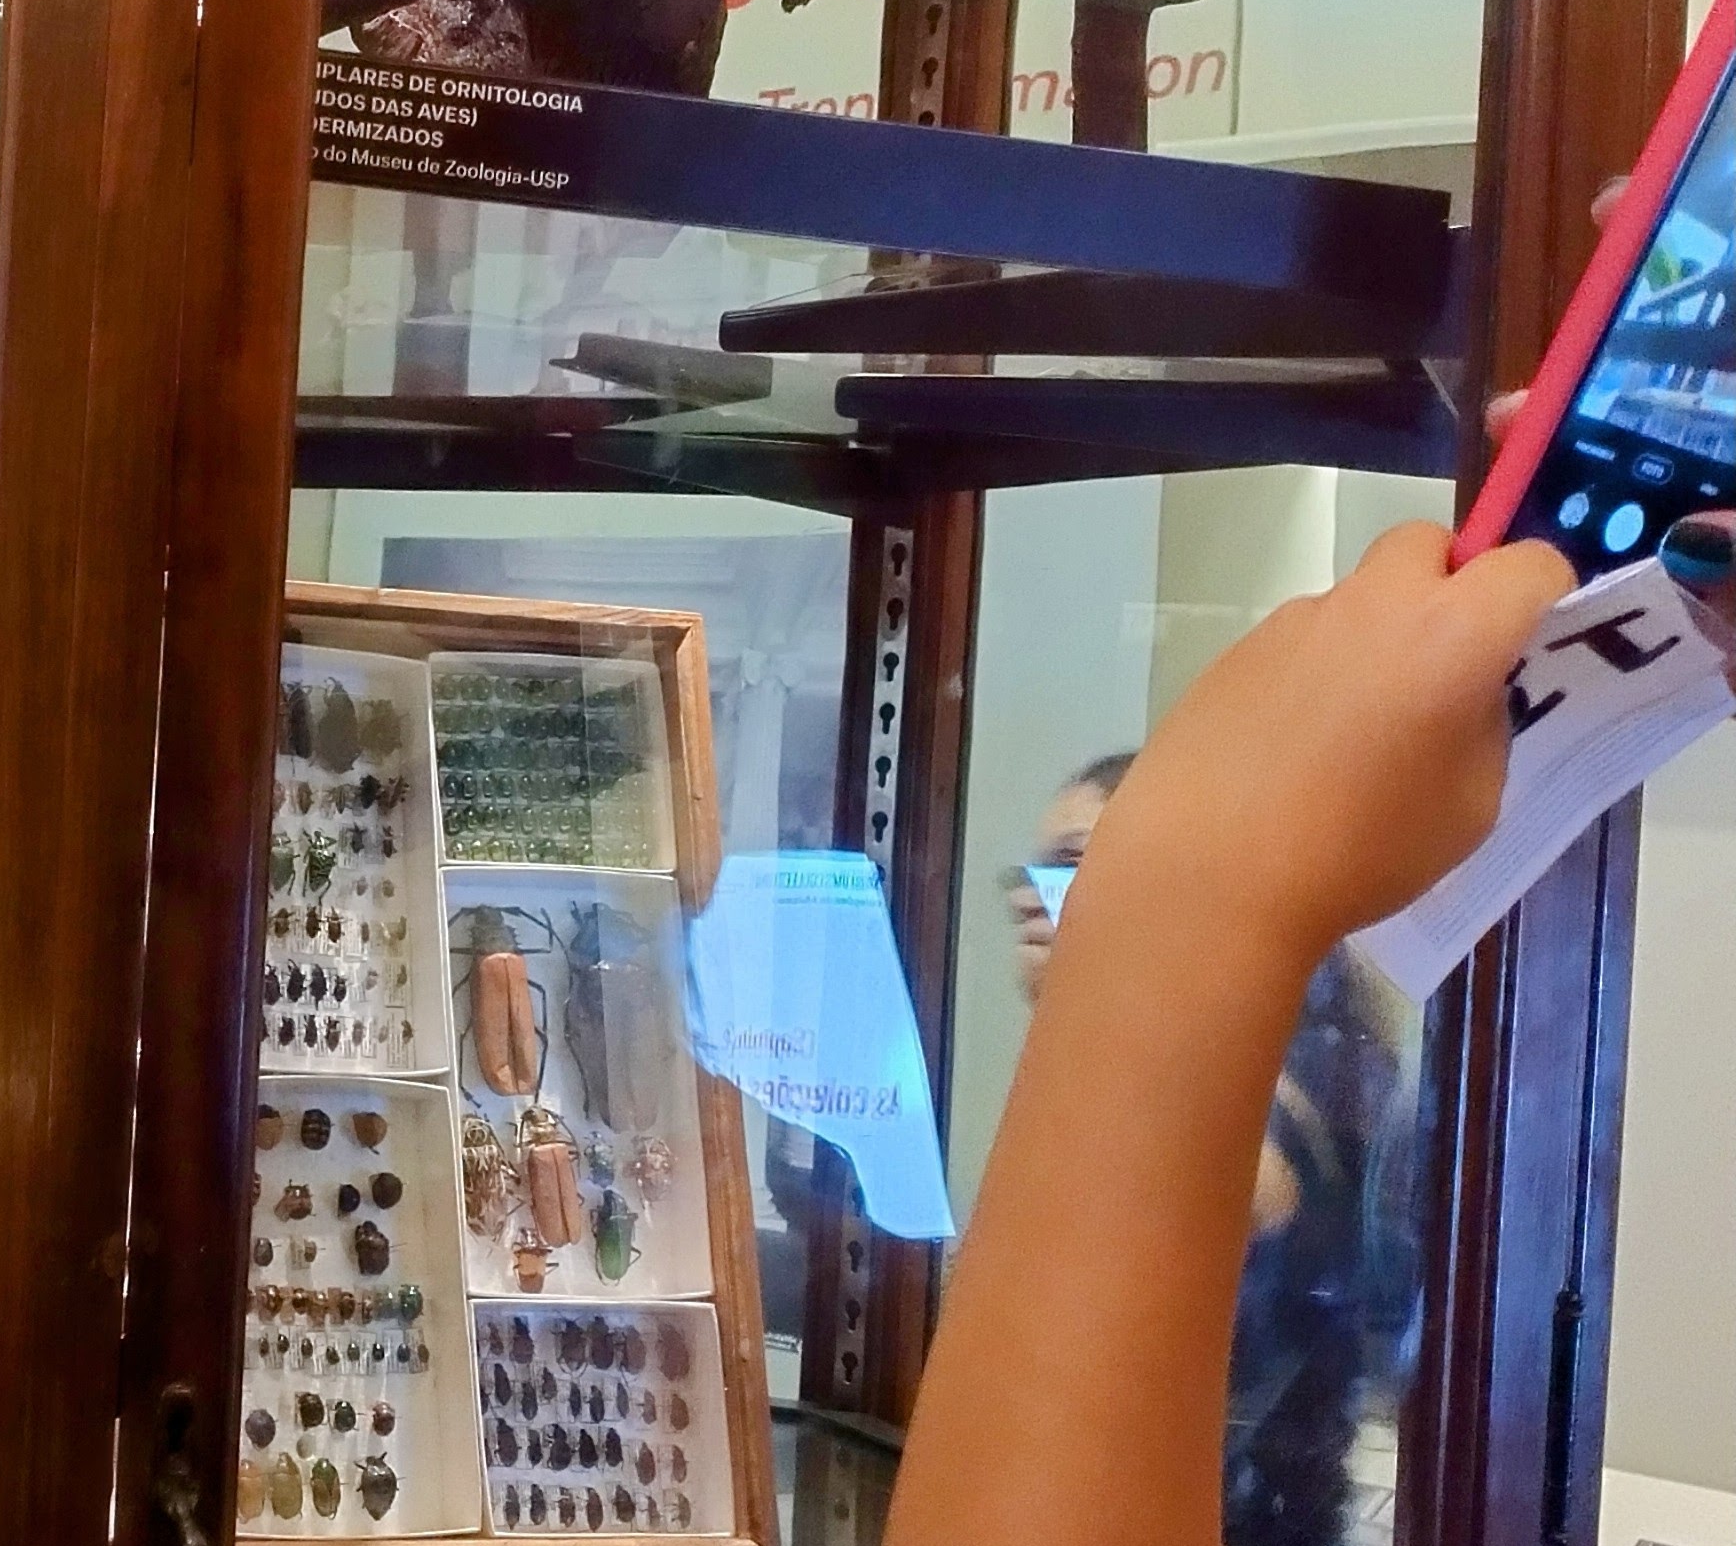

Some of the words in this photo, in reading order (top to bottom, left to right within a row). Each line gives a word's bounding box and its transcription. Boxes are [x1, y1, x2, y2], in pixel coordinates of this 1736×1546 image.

[371, 97, 413, 118] DAS
[417, 103, 478, 128] AVES)
[409, 75, 436, 94] DE
[441, 79, 583, 113] ORNITOLOGIA
[323, 145, 346, 163] do
[351, 148, 412, 171] Museu
[417, 157, 440, 174] de
[444, 159, 569, 190] Zoologia-USP
